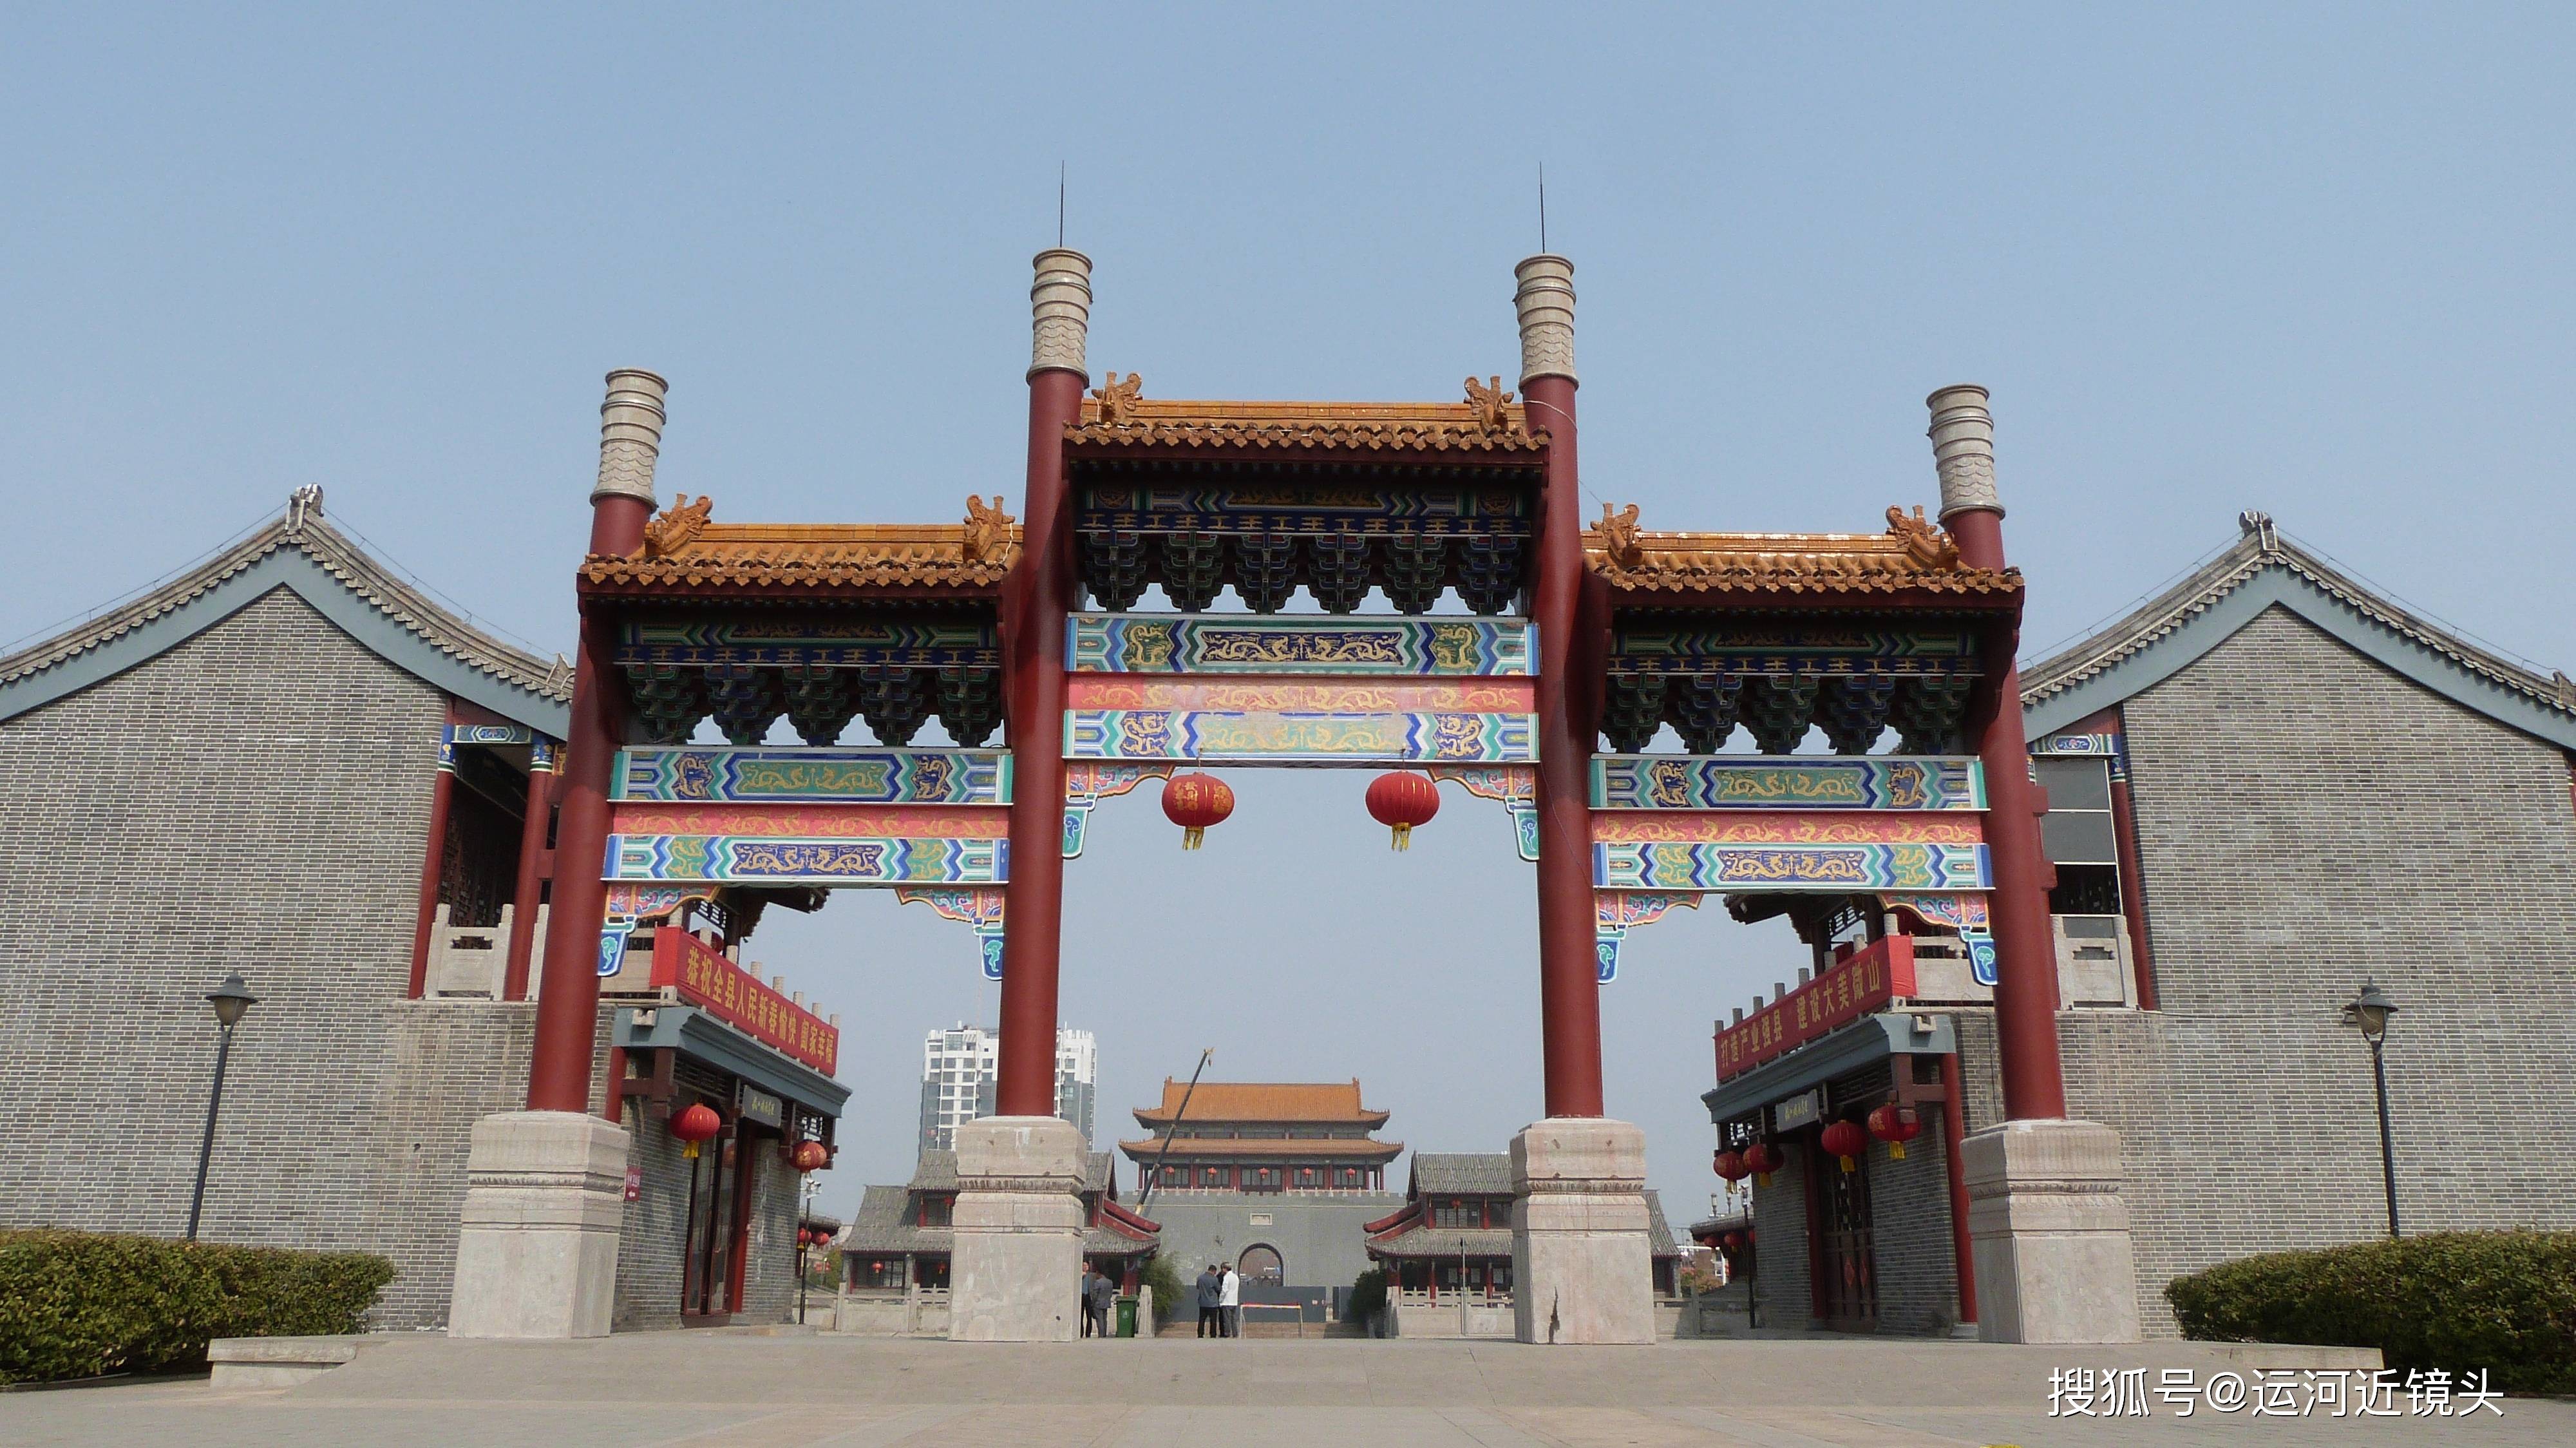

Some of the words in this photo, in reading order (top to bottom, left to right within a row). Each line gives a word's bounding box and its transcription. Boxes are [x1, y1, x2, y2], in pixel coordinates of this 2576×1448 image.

[1721, 1009, 1783, 1067] 打造产业强县
[1796, 954, 1880, 1030] 建设大美微山
